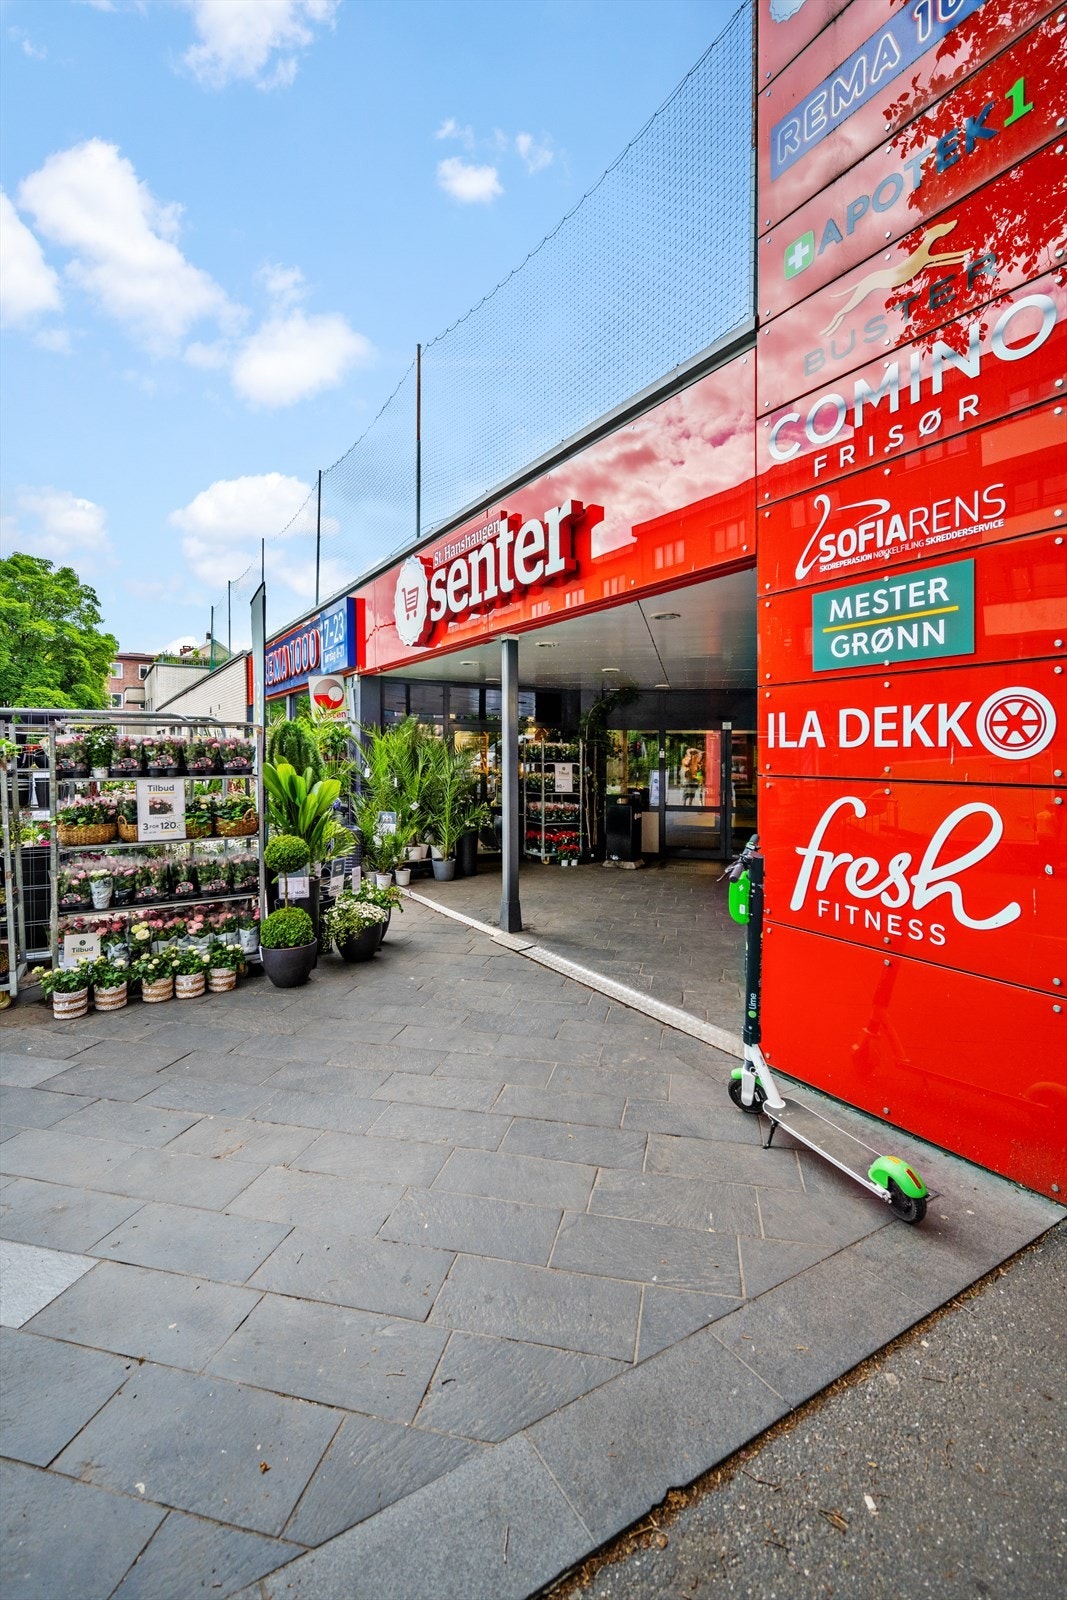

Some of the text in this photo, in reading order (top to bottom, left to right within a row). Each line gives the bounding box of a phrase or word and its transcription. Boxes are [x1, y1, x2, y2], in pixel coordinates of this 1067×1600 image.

[776, 32, 901, 166] REMA
[817, 76, 1034, 255] APOTEK 1
[803, 252, 1000, 377] BUSTER
[768, 294, 1058, 462] COMINO
[813, 393, 980, 478] FRISØR
[430, 499, 573, 622] senter
[444, 519, 500, 561] Hanshaugen
[819, 519, 1005, 573] SKOREPERASJON NØKKELFILING SKREDDERSERVICE
[829, 577, 949, 622] MESTER
[266, 629, 319, 685] EMA 1000
[830, 619, 945, 658] GRØNN
[767, 701, 973, 749] ILA DEKK
[789, 796, 1021, 930] fresh
[818, 899, 946, 946] FITNESS
[748, 993, 757, 1010] Lime
